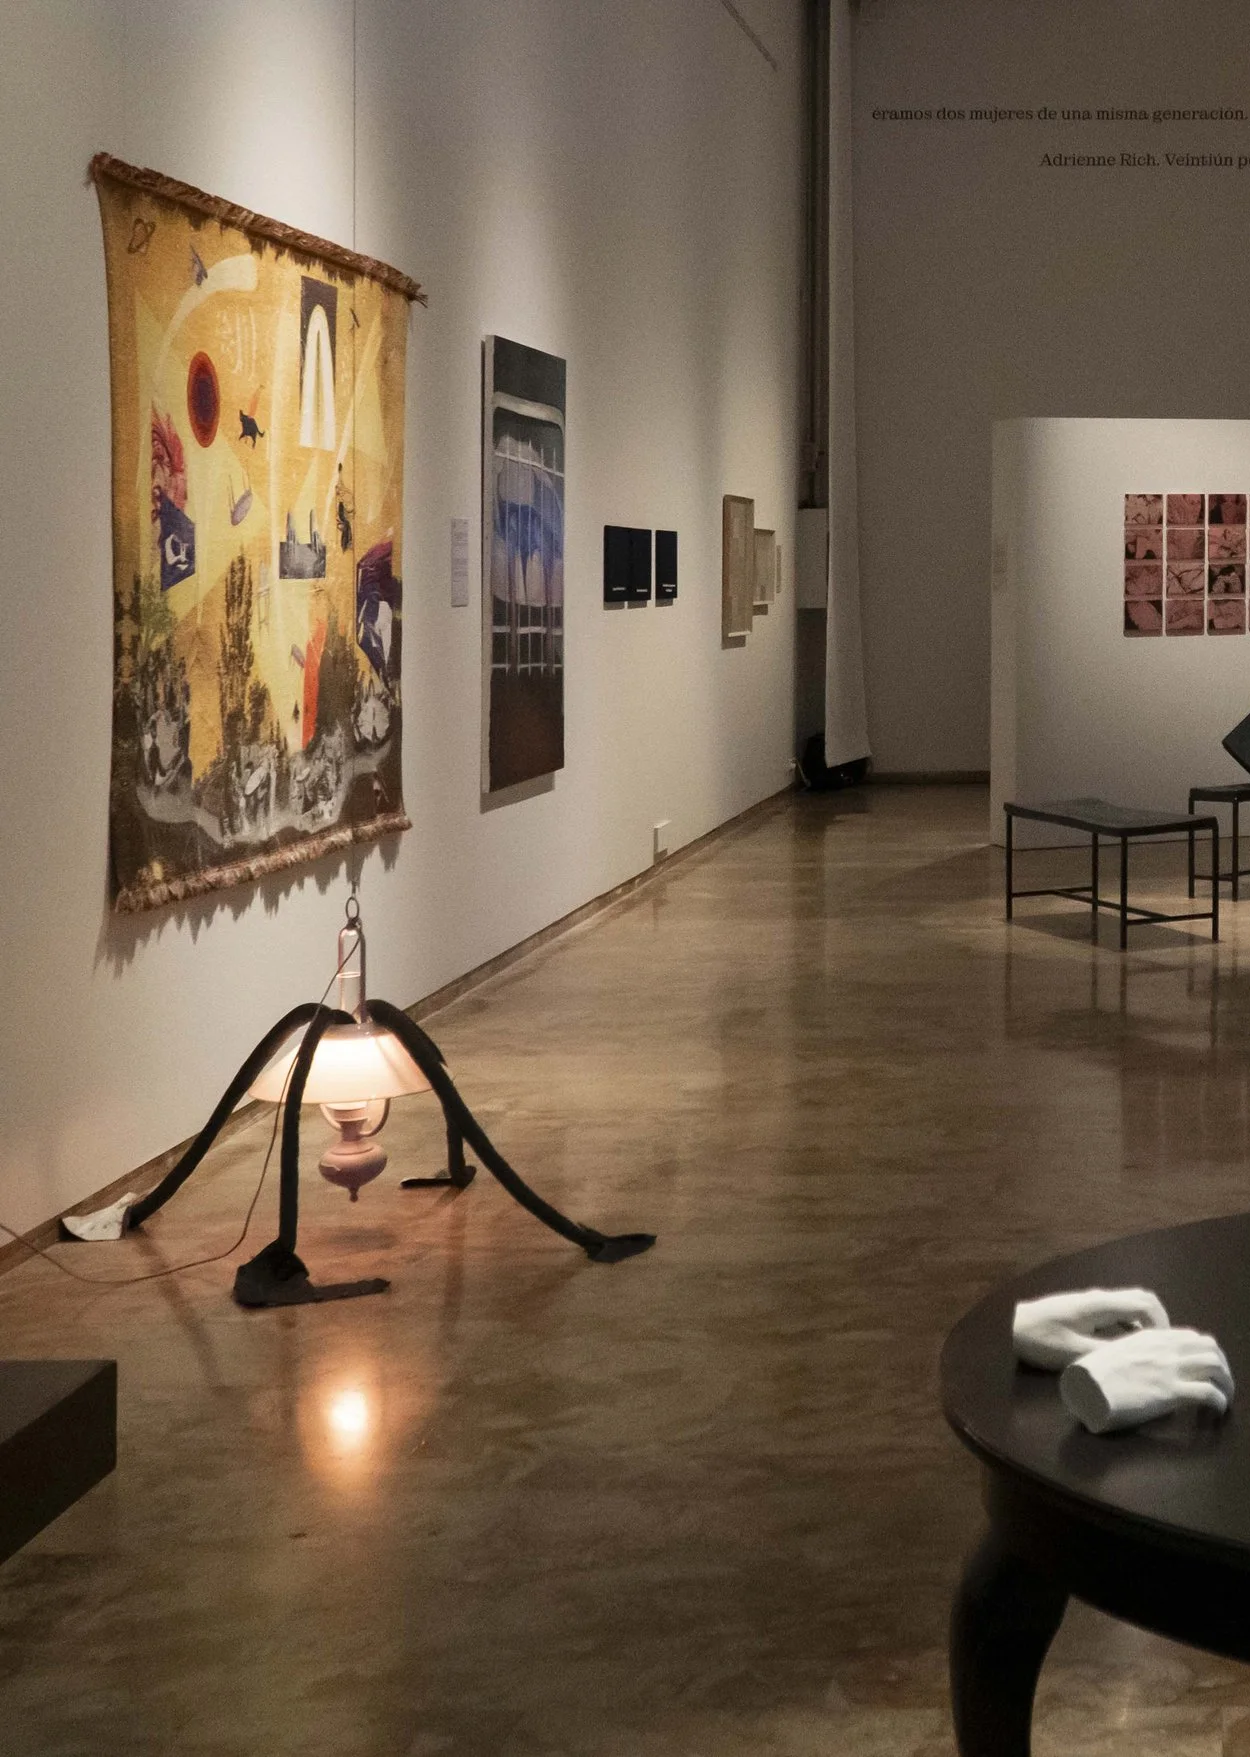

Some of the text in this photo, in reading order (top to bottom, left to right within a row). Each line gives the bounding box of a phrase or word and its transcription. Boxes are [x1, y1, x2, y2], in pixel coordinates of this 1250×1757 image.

[936, 106, 965, 120] dos
[969, 106, 1034, 123] mujeres
[1037, 106, 1057, 120] de
[1061, 109, 1092, 120] una
[1096, 106, 1149, 120] misma
[1152, 106, 1248, 123] generación.
[1039, 152, 1116, 167] Adrienne
[1120, 152, 1160, 167] Rich.
[1165, 152, 1233, 167] Veintiún
